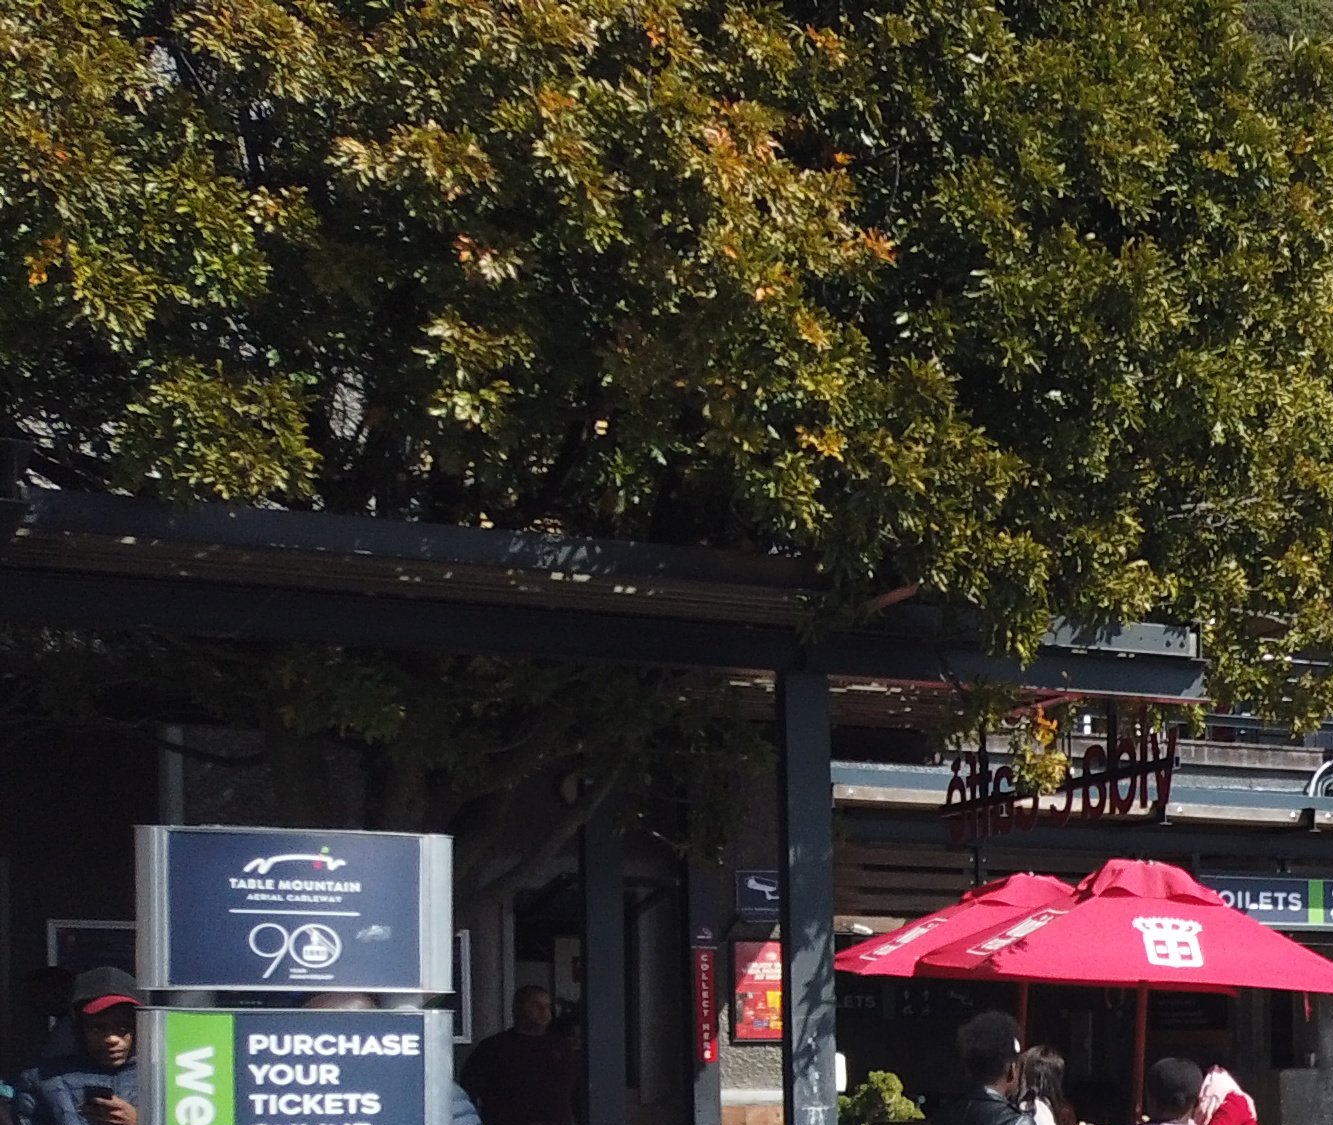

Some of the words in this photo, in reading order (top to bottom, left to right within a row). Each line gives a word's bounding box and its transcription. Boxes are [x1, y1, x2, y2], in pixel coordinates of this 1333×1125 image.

[229, 878, 275, 889] TABLE
[278, 880, 361, 892] MOUNTAIN
[286, 895, 342, 903] CABLEWAY
[1213, 889, 1303, 912] OILETS
[700, 954, 711, 1017] COLLECT
[248, 1033, 421, 1057] PURCHASE
[248, 1063, 339, 1086] YOUR
[249, 1093, 381, 1116] TICKETS
